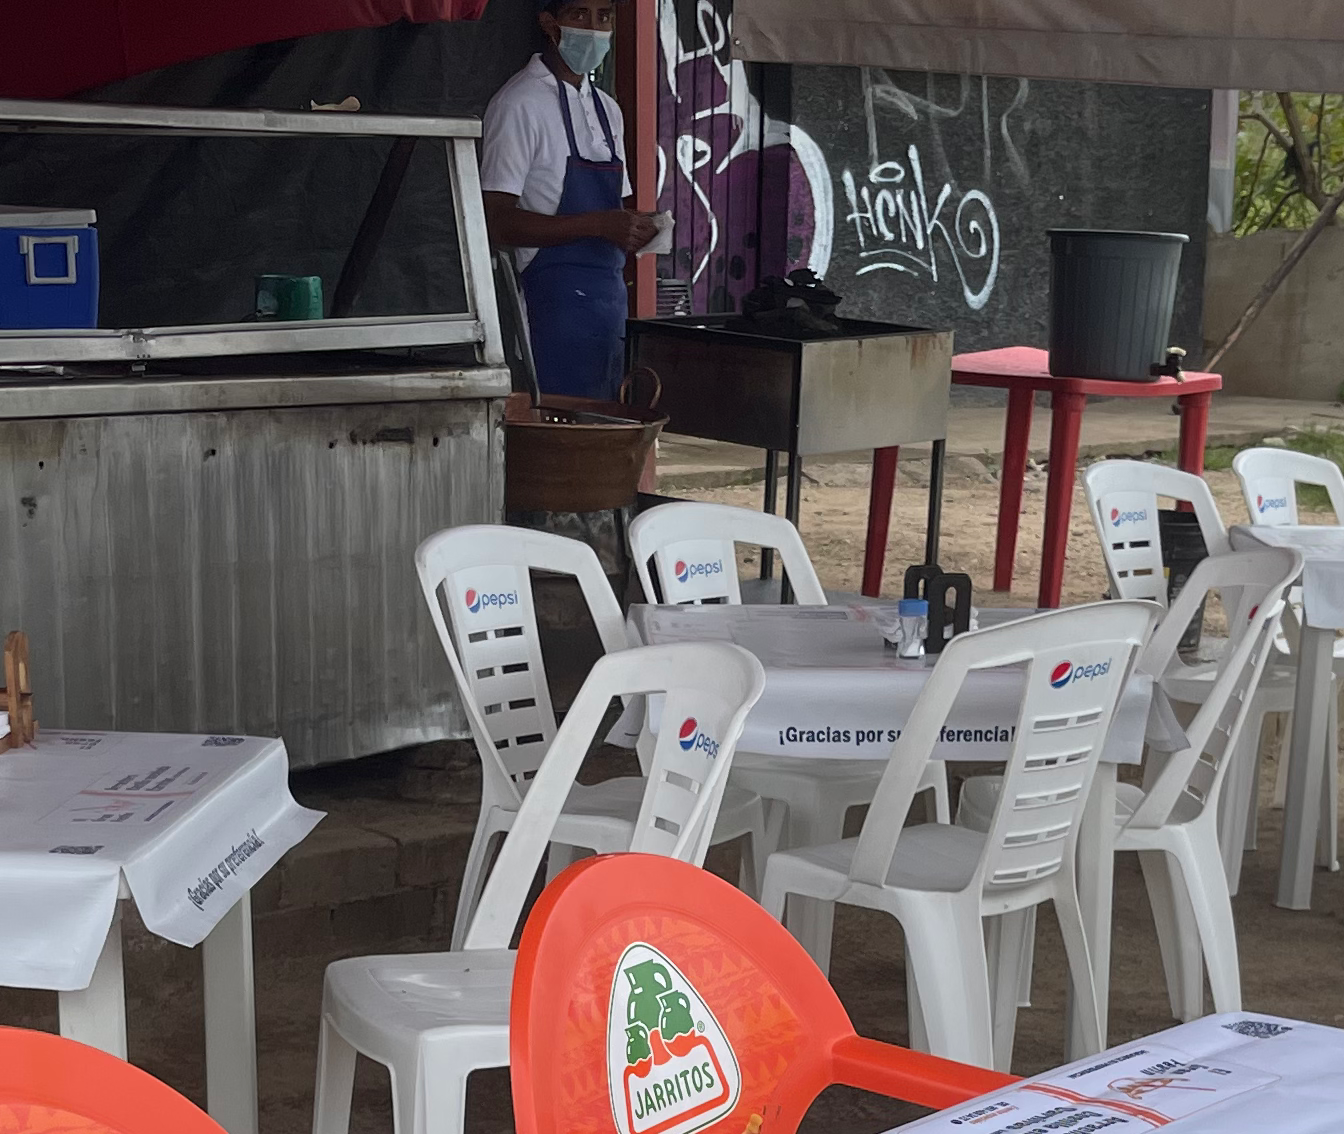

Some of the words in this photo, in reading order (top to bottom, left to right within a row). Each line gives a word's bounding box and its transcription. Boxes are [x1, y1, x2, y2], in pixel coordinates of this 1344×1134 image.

[689, 558, 723, 578] pepsi
[481, 590, 518, 610] pepsi
[1072, 658, 1112, 682] pepsi
[695, 733, 720, 759] peps
[779, 726, 851, 746] ¡Gracias
[855, 730, 883, 746] por
[635, 1062, 715, 1120] JARRITOS
